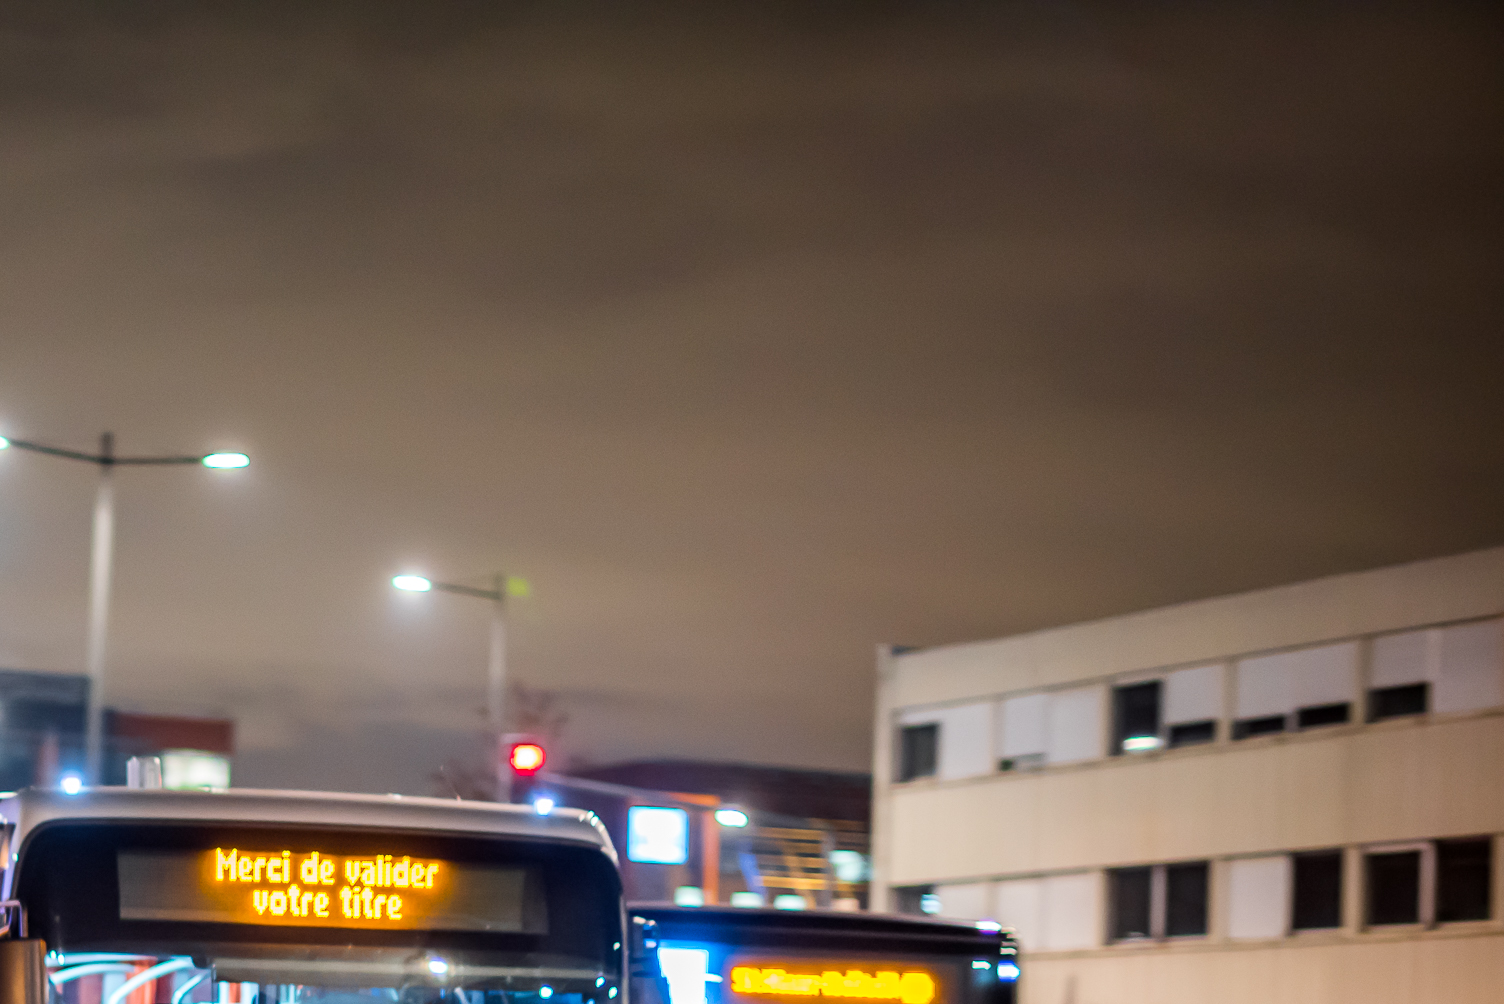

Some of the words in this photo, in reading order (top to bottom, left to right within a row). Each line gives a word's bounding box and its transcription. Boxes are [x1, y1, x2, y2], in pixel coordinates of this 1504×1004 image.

[215, 847, 291, 884] Merci
[300, 851, 336, 886] de
[344, 854, 439, 889] valider
[252, 884, 330, 918] votre
[339, 886, 403, 920] titre
